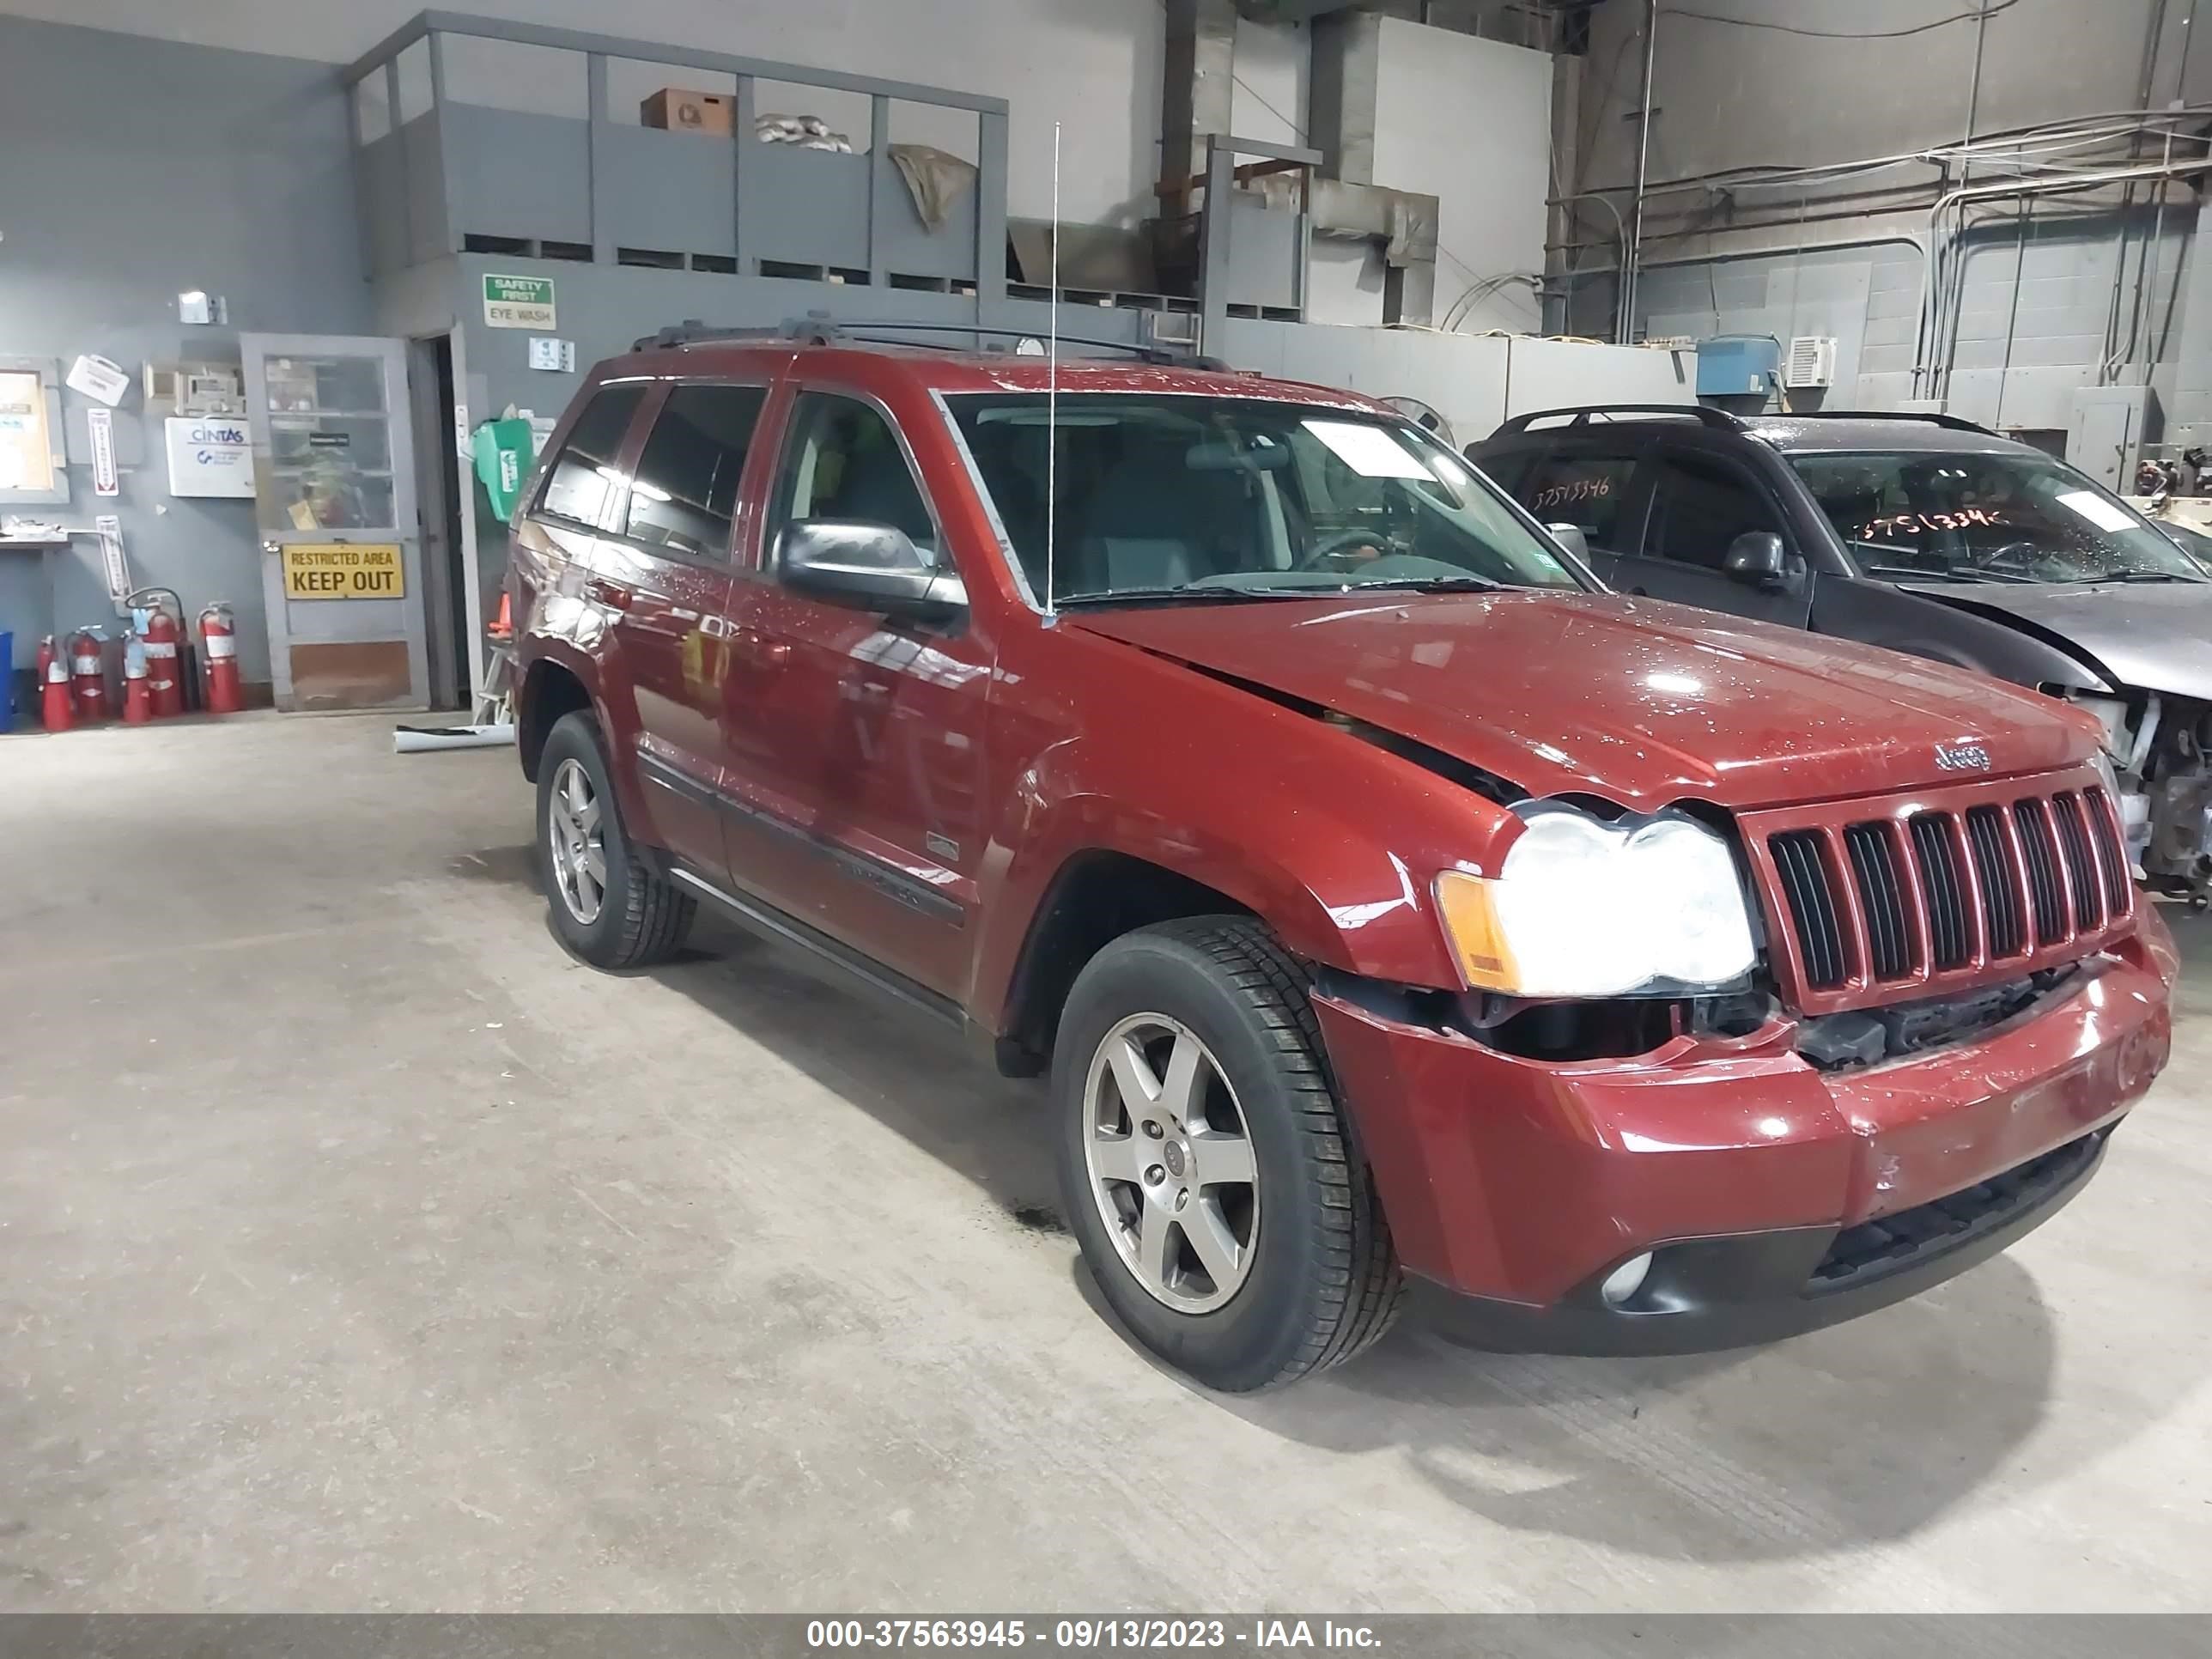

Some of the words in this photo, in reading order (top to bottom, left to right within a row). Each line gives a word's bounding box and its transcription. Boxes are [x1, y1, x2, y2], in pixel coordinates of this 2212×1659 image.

[495, 279, 543, 291] SAFETY
[501, 290, 536, 301] FIRST
[489, 308, 512, 319] EYE
[517, 310, 550, 321] WASH
[1534, 476, 1609, 511] 37513346
[291, 552, 359, 566] RESTRICTED
[363, 552, 393, 566] AREA
[293, 571, 345, 591] KEEP
[353, 571, 394, 591] OUT
[1934, 744, 1990, 773] Jeep
